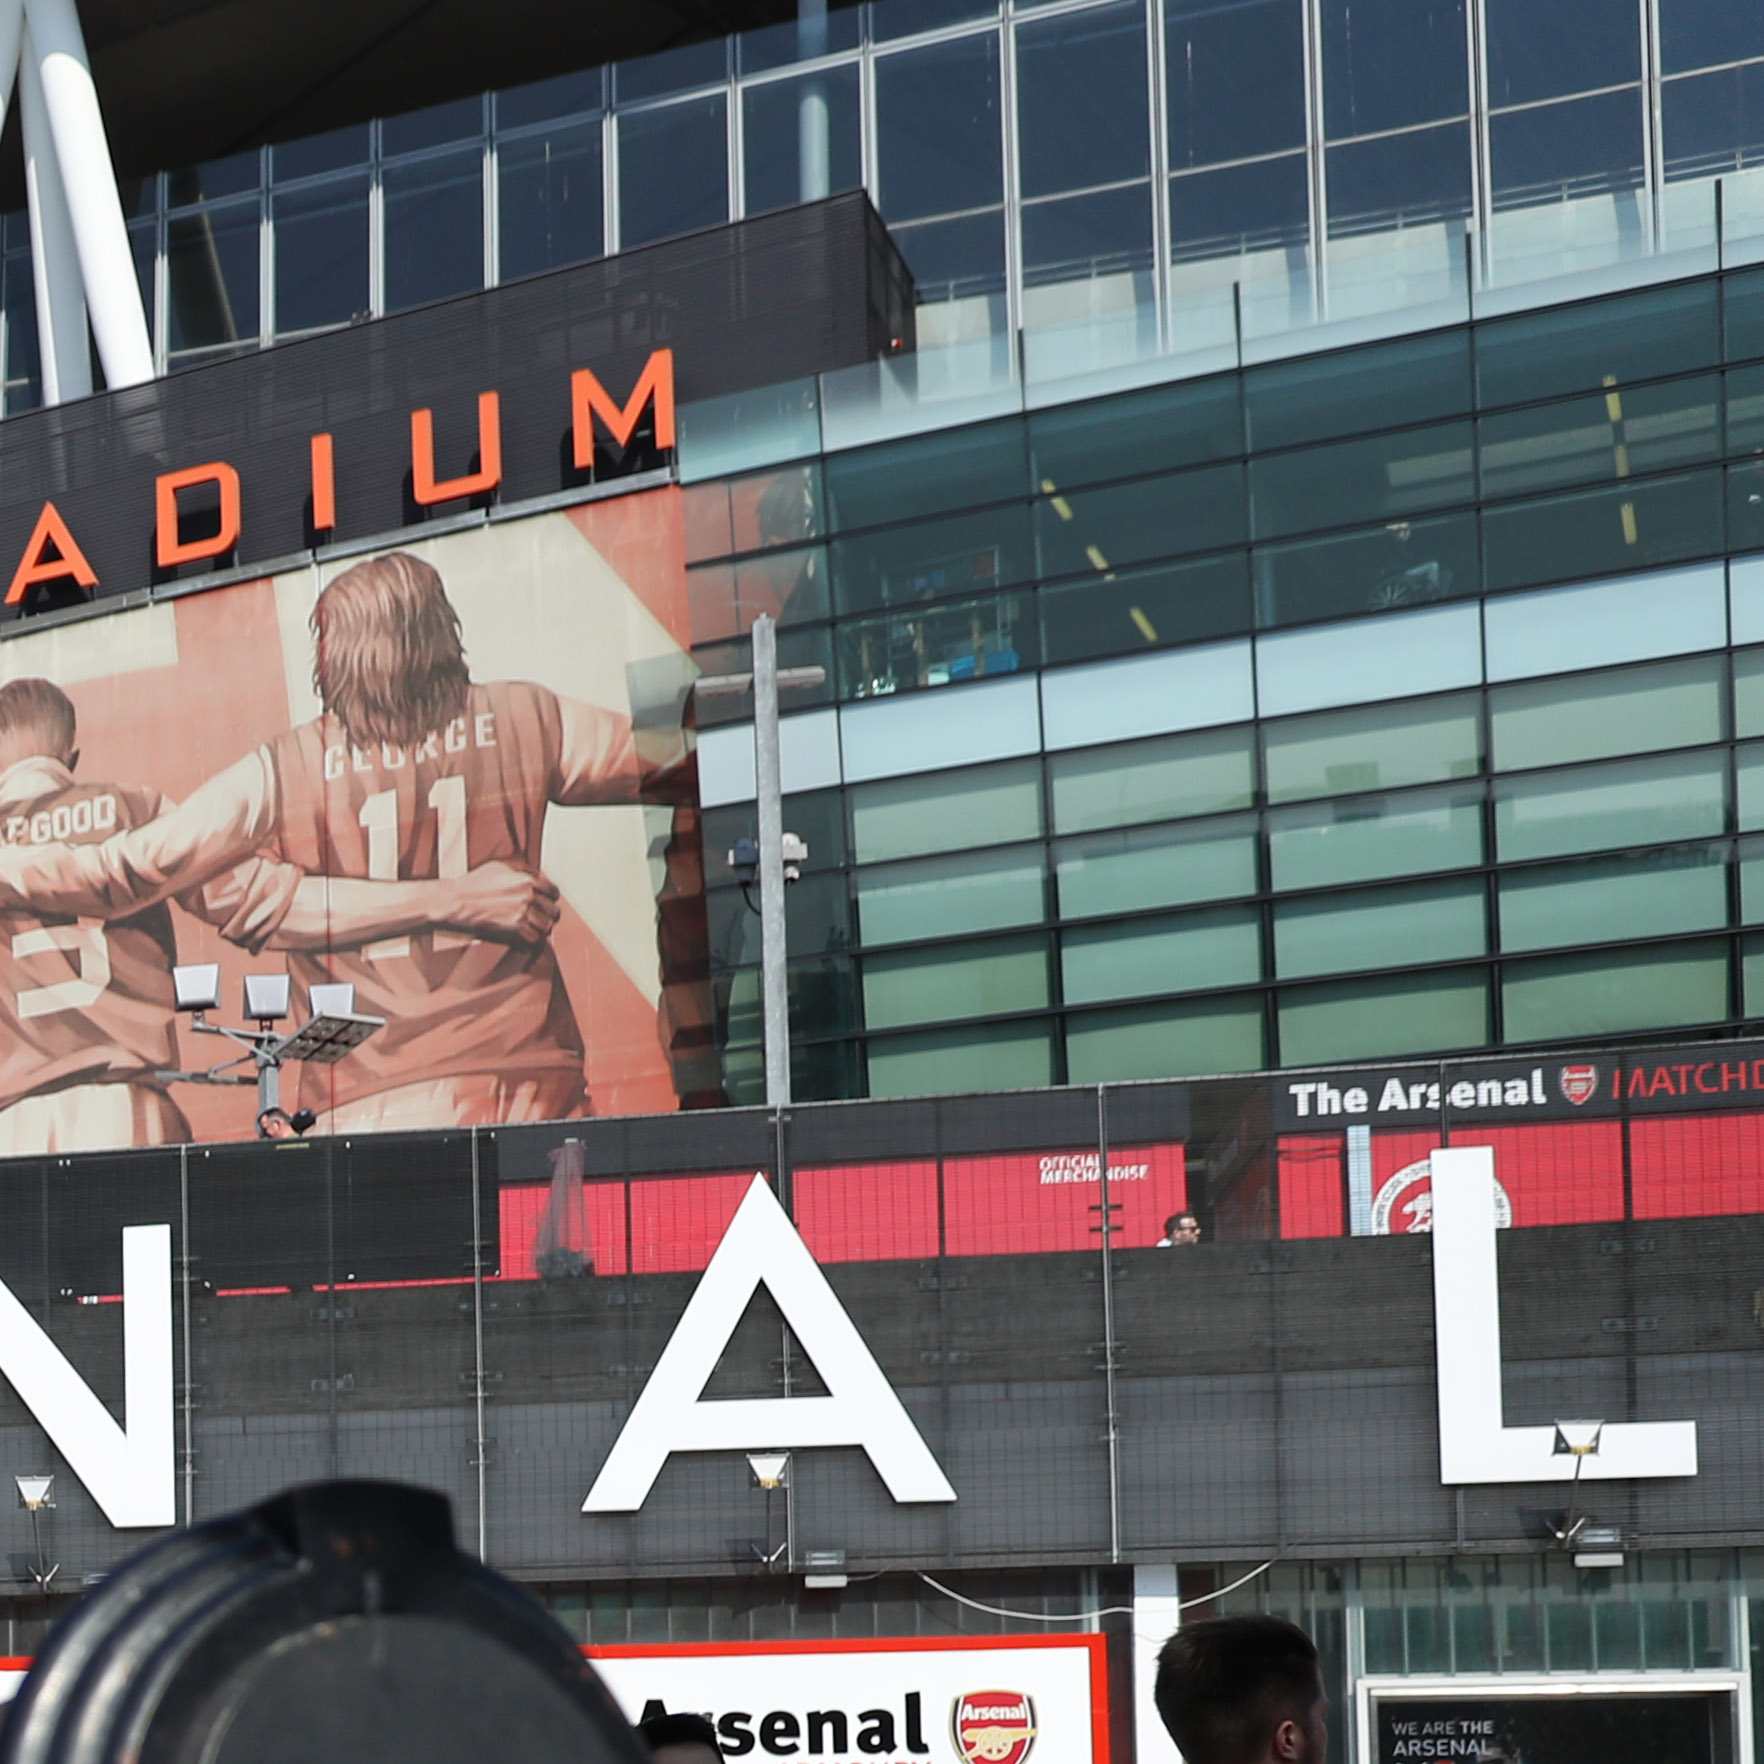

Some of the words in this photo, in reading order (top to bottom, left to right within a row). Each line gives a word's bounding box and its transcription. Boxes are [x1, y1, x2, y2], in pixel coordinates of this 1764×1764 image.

[1289, 1082, 1369, 1117] The
[1377, 1067, 1547, 1112] Arsenal
[961, 1703, 1026, 1722] Arsenal
[639, 1690, 930, 1757] senal
[1391, 1721, 1419, 1736] WE
[1422, 1721, 1456, 1736] ARE
[1459, 1719, 1494, 1735] THE
[1392, 1739, 1494, 1757] ARSENAL
